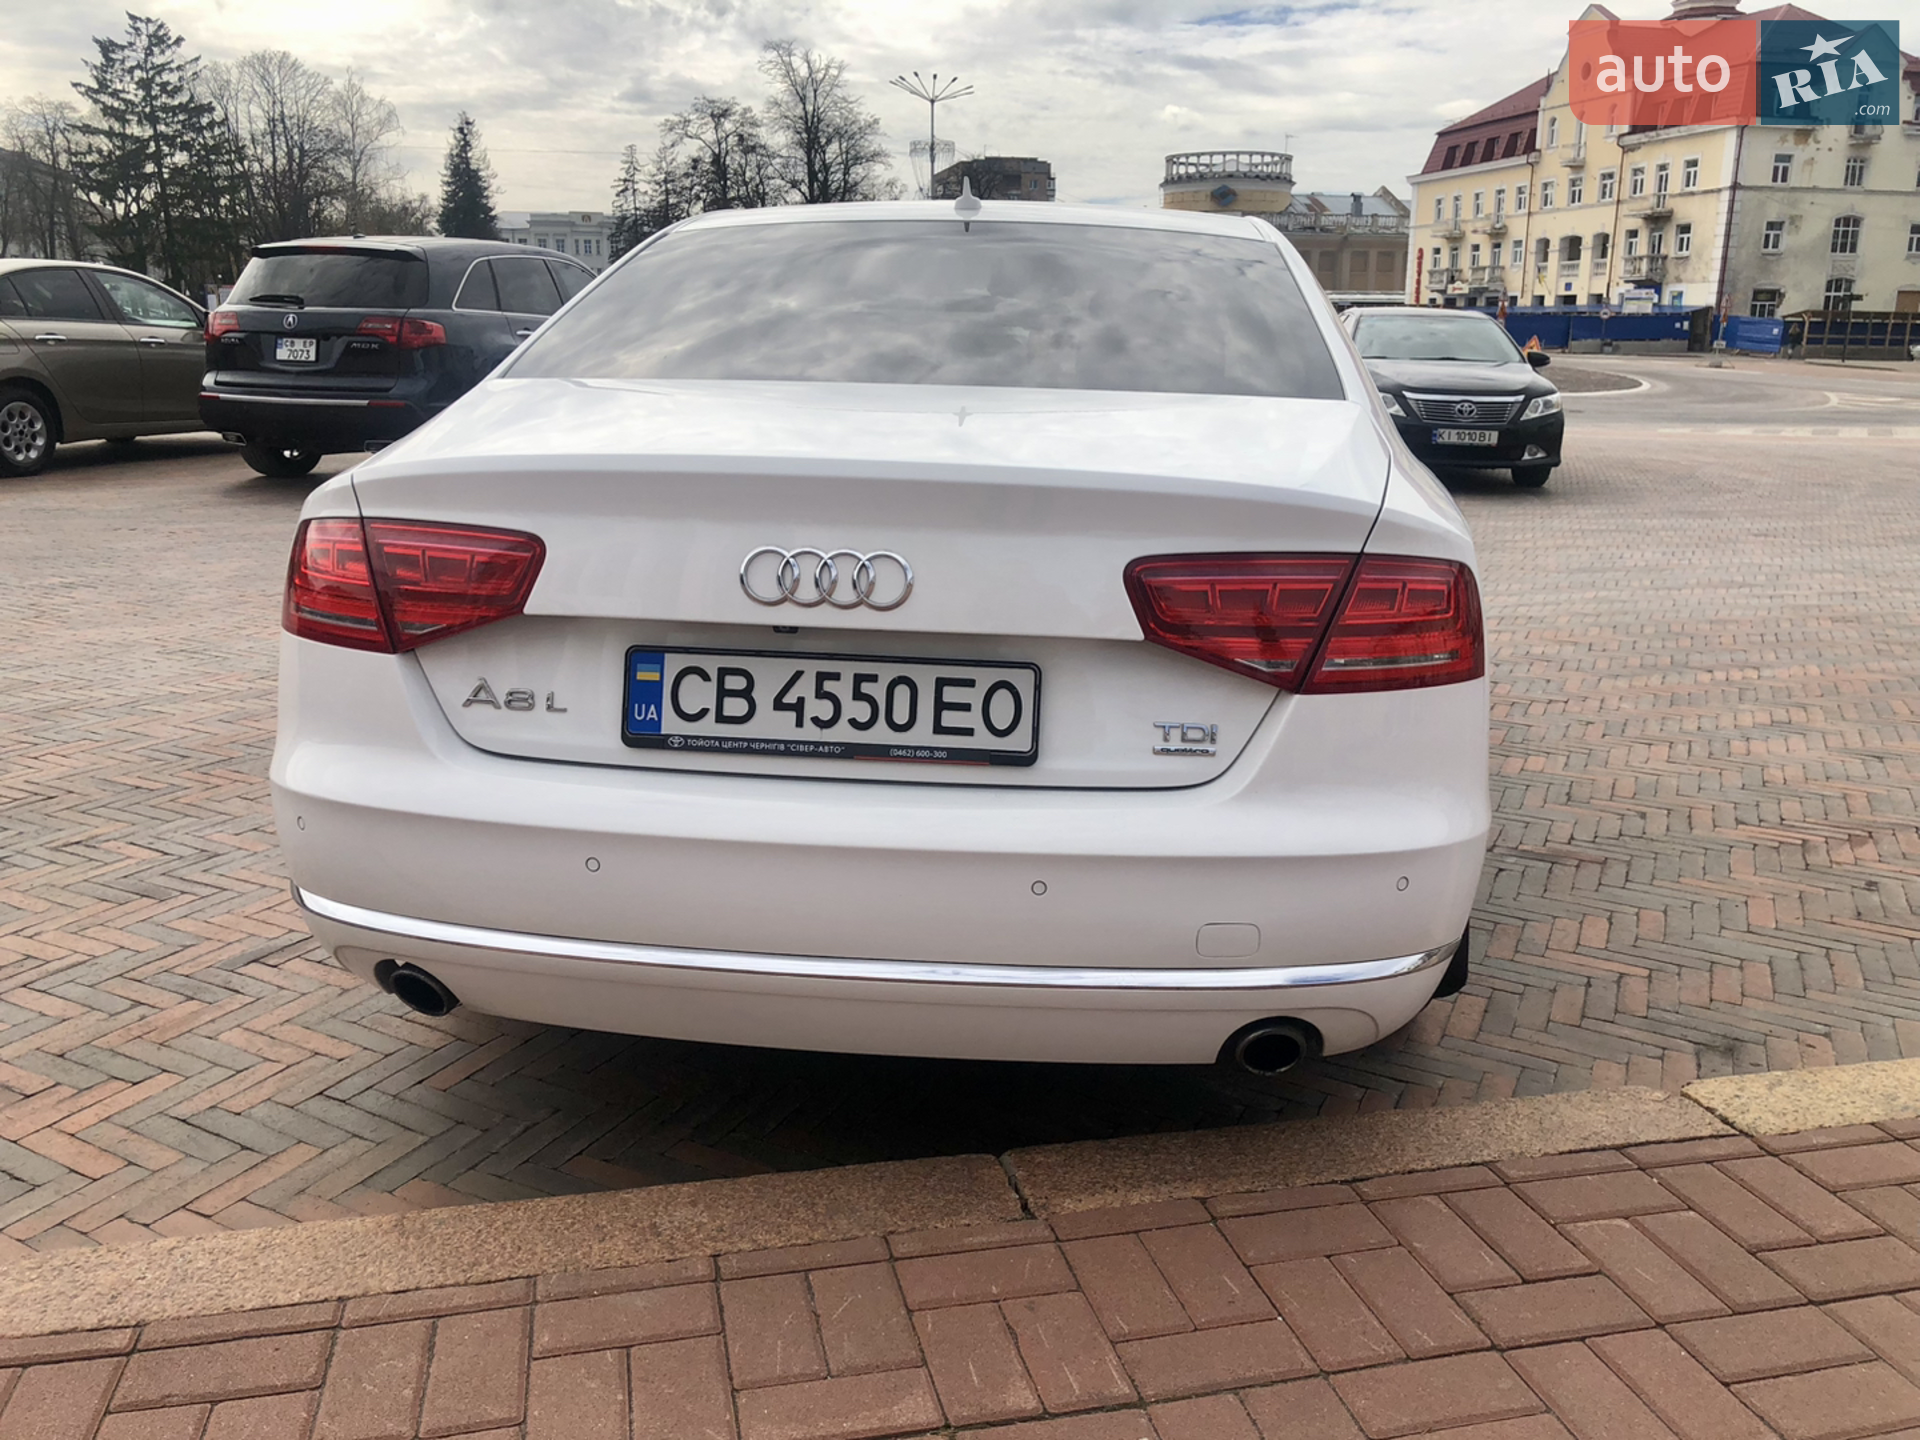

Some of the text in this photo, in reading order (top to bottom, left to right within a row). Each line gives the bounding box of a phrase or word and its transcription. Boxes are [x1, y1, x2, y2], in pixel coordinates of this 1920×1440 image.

[286, 348, 311, 360] 7073
[670, 665, 1023, 738] CB 4550 EO
[633, 703, 659, 722] UA
[1152, 721, 1219, 745] TDI
[686, 738, 721, 748] ТОЙОТА
[721, 740, 749, 749] ЦЕНТР
[888, 748, 948, 758] (0462) 600-300
